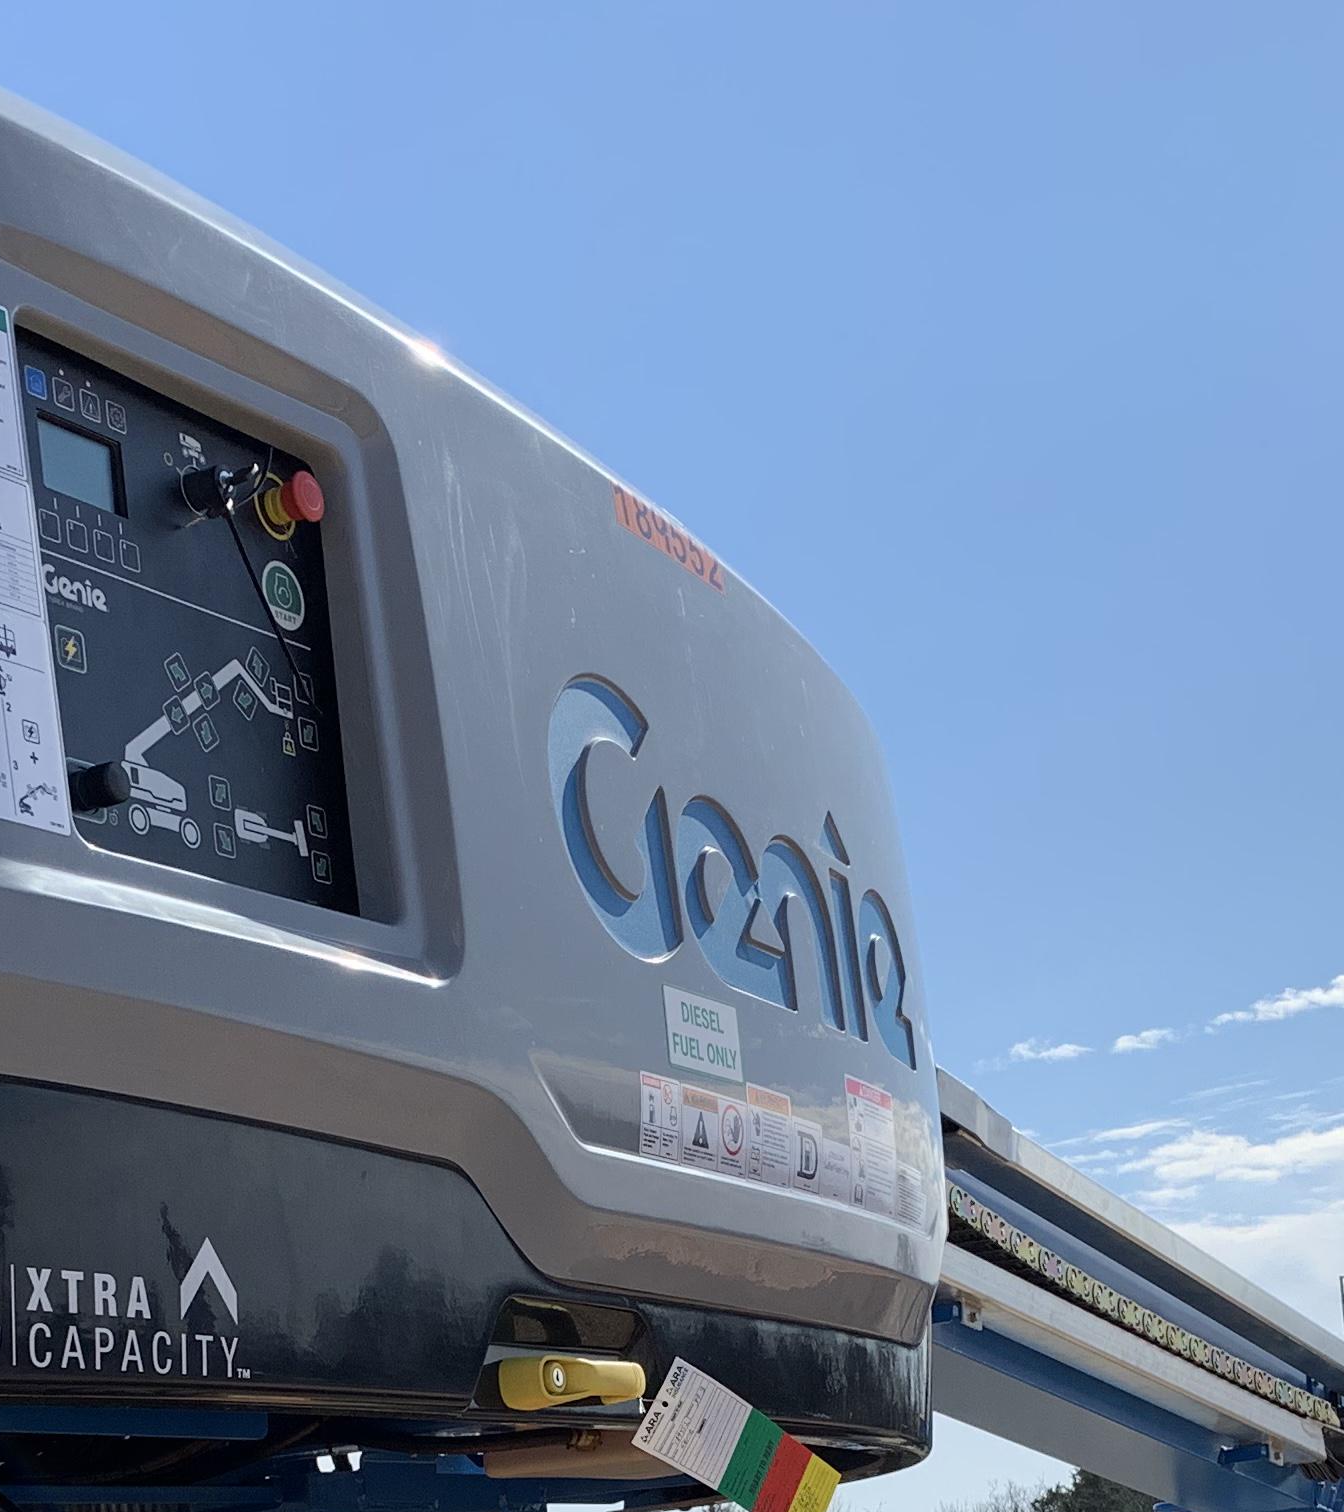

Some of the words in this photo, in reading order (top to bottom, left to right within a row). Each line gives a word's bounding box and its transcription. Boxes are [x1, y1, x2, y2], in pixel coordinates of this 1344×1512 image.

[42, 563, 109, 613] Genie
[274, 609, 298, 626] START
[5, 702, 12, 712] 2
[12, 760, 19, 771] 3
[547, 672, 916, 1071] Genie
[680, 1000, 724, 1035] DIESEL
[672, 1031, 705, 1063] FUEL
[706, 1043, 737, 1071] ONLY
[26, 1267, 152, 1320] XTRA
[28, 1323, 239, 1379] CAPACITY
[670, 1365, 684, 1387] ARA
[645, 1411, 662, 1432] ARA
